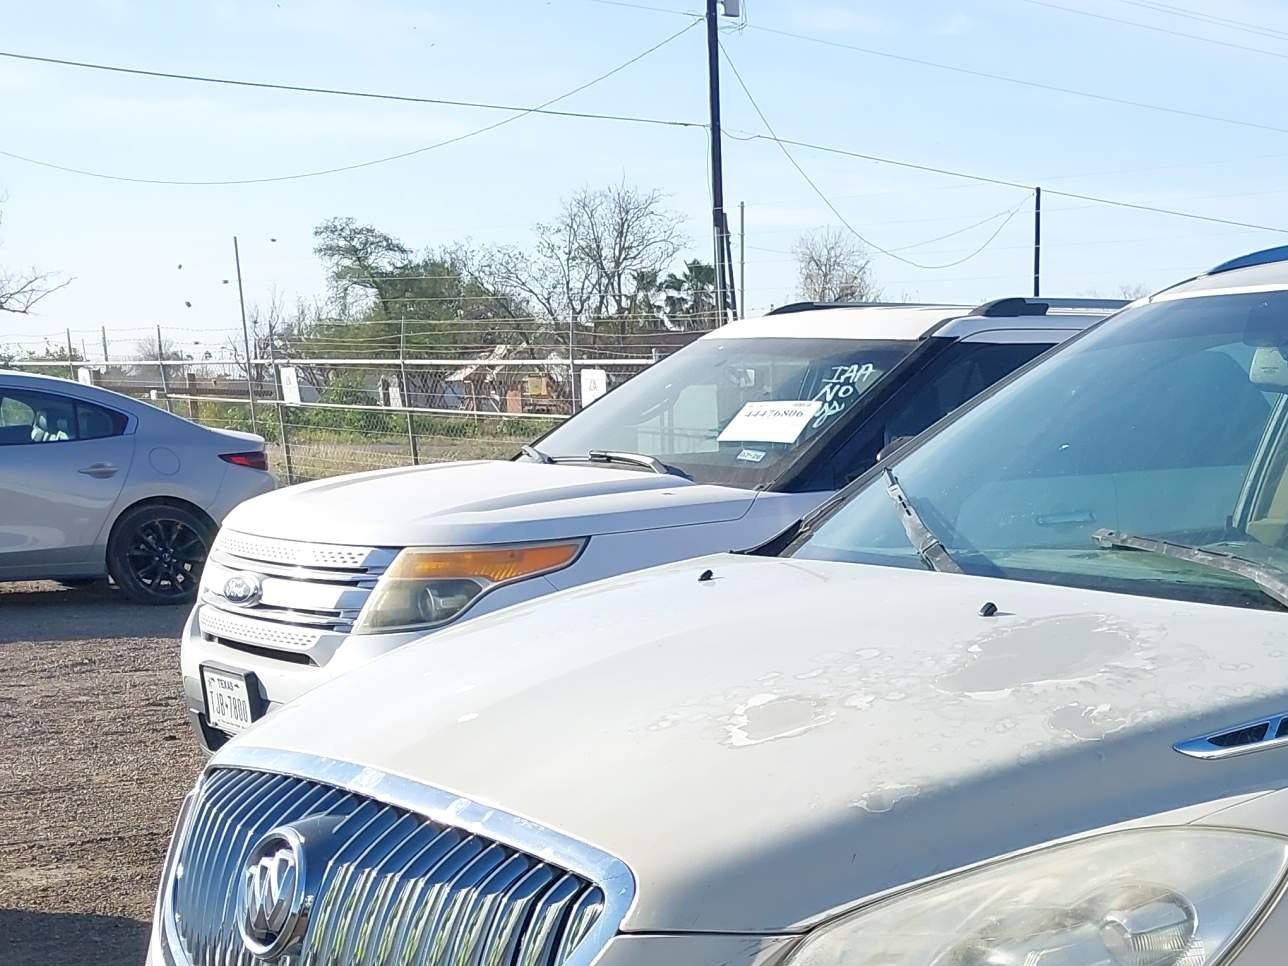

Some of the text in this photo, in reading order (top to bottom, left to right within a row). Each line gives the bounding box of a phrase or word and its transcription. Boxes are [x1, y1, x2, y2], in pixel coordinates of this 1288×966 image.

[821, 362, 877, 383] IAA
[811, 383, 853, 402] NO
[217, 678, 234, 691] TEXAS
